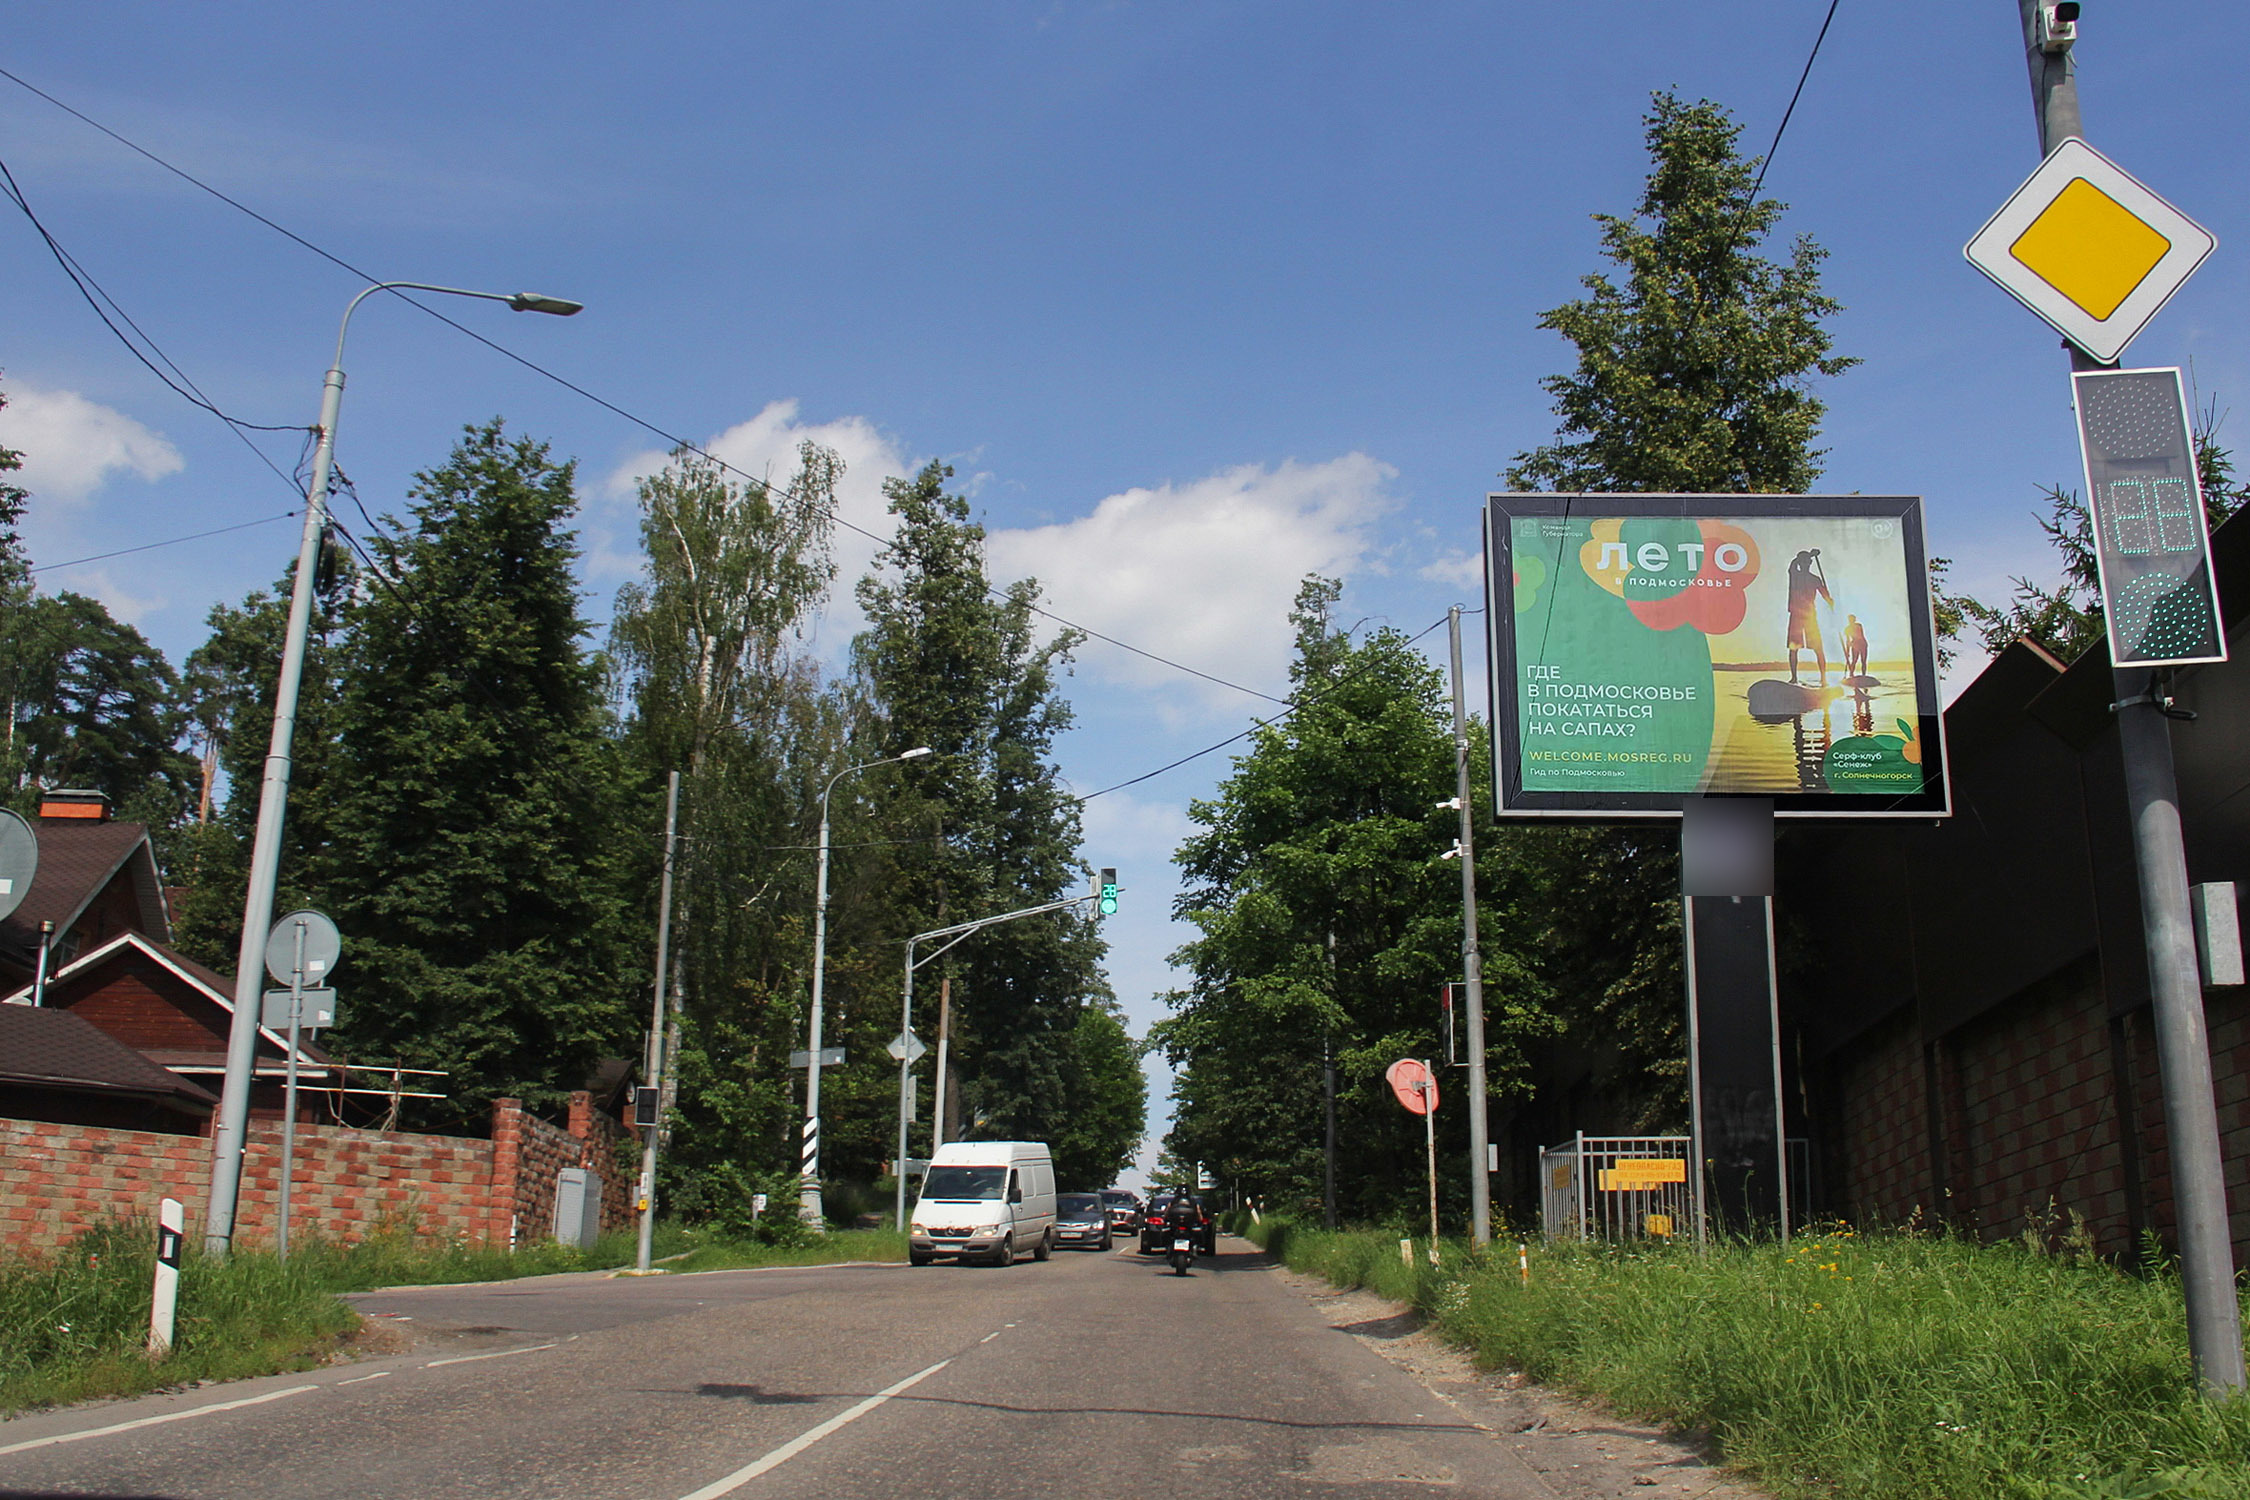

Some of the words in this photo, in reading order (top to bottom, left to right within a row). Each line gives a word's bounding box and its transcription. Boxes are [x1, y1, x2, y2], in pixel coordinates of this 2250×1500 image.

[1527, 665, 1561, 681] ГДЕ
[1527, 684, 1540, 698] В
[1546, 684, 1696, 700] ПОДМОСКОВЬЕ
[1528, 702, 1653, 719] ПОКАТАТЬСЯ
[1529, 721, 1557, 736] НА
[1561, 722, 1636, 737] САПАХ?
[1529, 751, 1692, 763] WELCOME.MOSREG.RU
[1832, 751, 1882, 761] Серф-клуб
[1530, 768, 1546, 777] Гид
[1548, 769, 1559, 777] по
[1562, 768, 1625, 777] Подмосковью
[1842, 771, 1913, 780] Солнечногорск
[1102, 884, 1117, 898] 28
